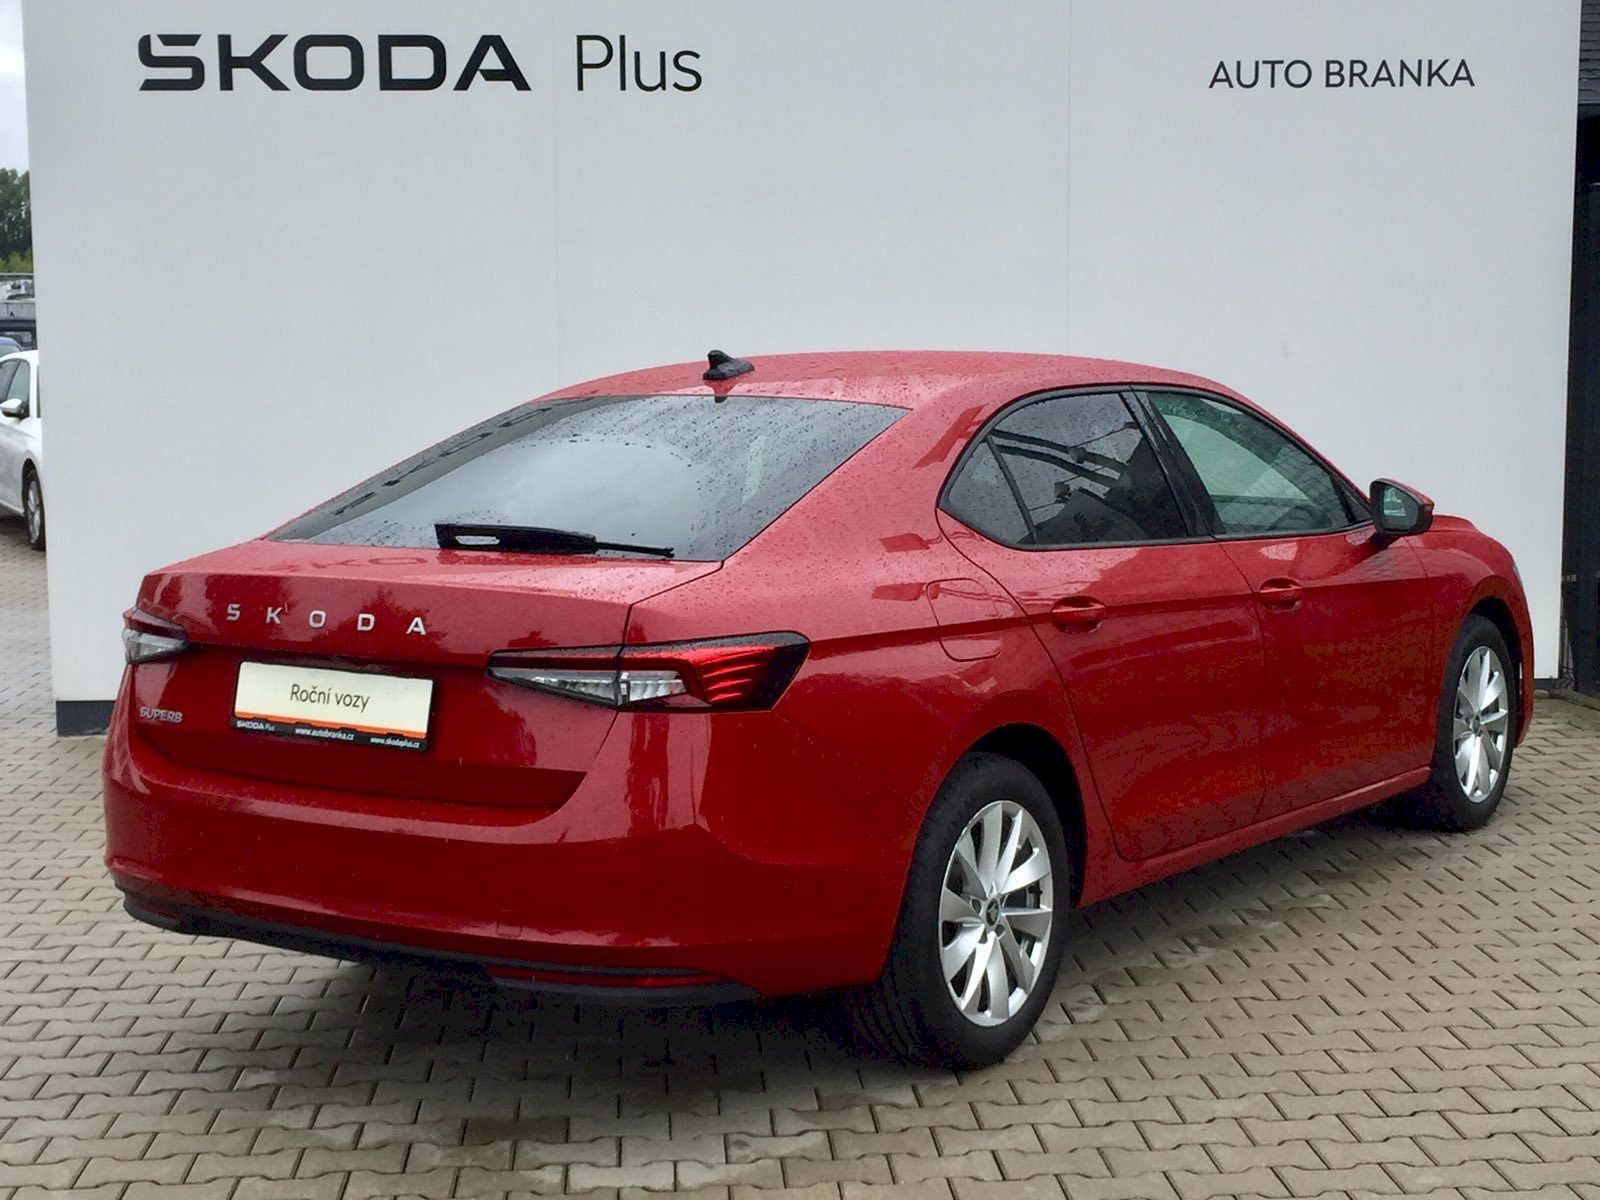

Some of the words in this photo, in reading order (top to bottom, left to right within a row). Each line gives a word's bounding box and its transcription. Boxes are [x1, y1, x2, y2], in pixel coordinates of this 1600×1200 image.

[576, 34, 702, 92] Plus
[1208, 60, 1313, 89] AUTO
[1325, 59, 1476, 88] BRANKA
[290, 683, 332, 705] Roční
[334, 692, 371, 713] vozy
[140, 706, 183, 723] SUPERB
[295, 728, 355, 741] www.autobranka.cz
[370, 737, 420, 749] www.skodaplus.cz
